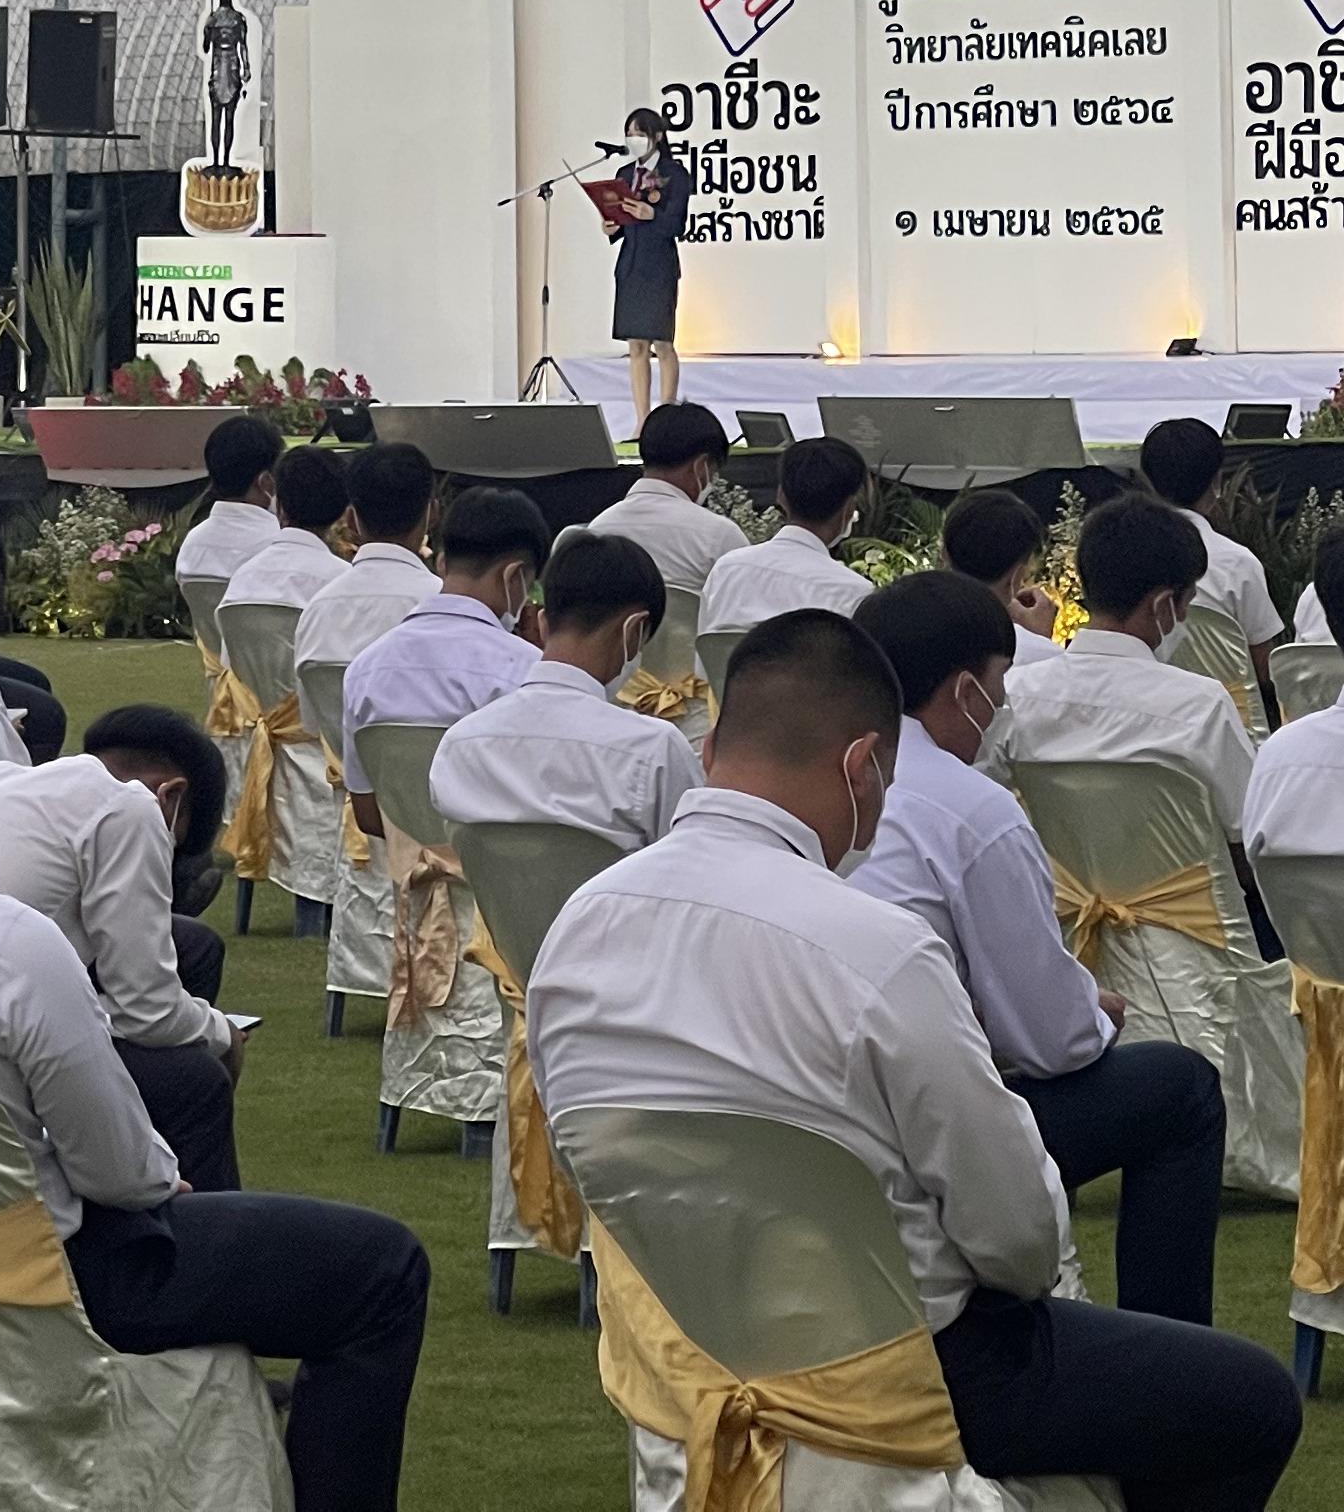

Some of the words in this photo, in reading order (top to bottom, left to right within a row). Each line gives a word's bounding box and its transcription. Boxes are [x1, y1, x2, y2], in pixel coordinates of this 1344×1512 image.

[885, 16, 1167, 65] วิทยาลัยเทคนิคเลย
[660, 58, 821, 132] อาชีวะ
[885, 84, 1057, 131] ปีการศึกษา
[1073, 95, 1174, 126] ๒๕๖๔
[895, 210, 918, 236] ๑
[933, 209, 1051, 237] เมษายน
[1065, 204, 1164, 236] ๒๕๖๕
[138, 284, 285, 324] HANGE
